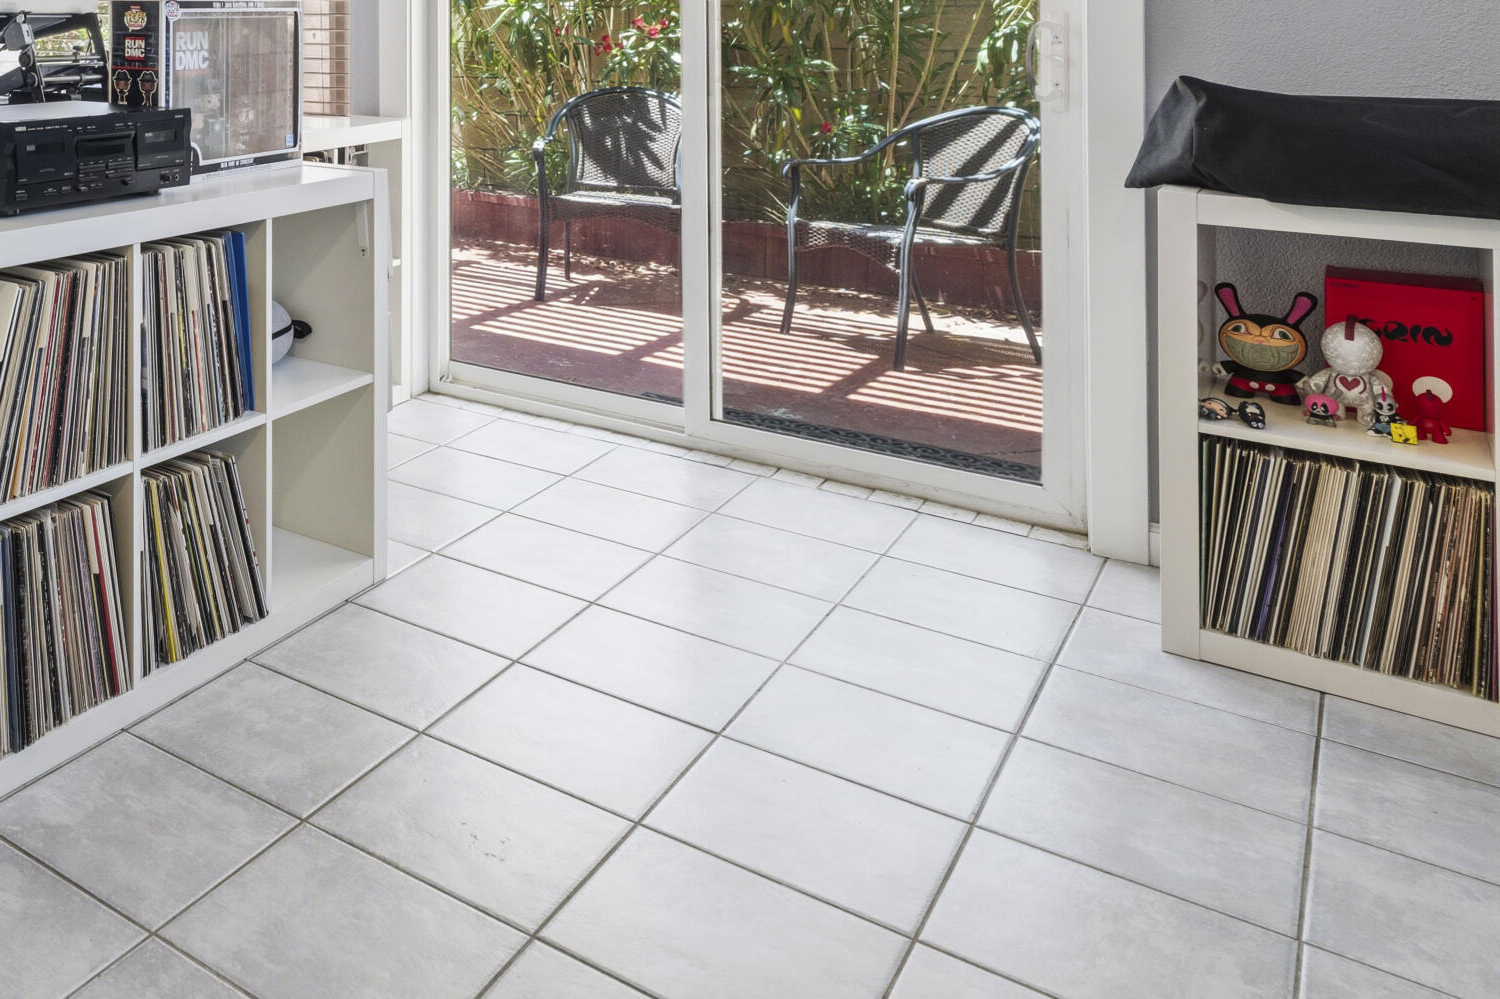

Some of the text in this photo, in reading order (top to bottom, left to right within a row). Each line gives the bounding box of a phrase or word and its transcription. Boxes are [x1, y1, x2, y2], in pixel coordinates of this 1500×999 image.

[125, 39, 145, 48] RUN
[175, 31, 209, 50] RUN
[125, 48, 145, 57] DMC
[175, 50, 209, 71] DMC
